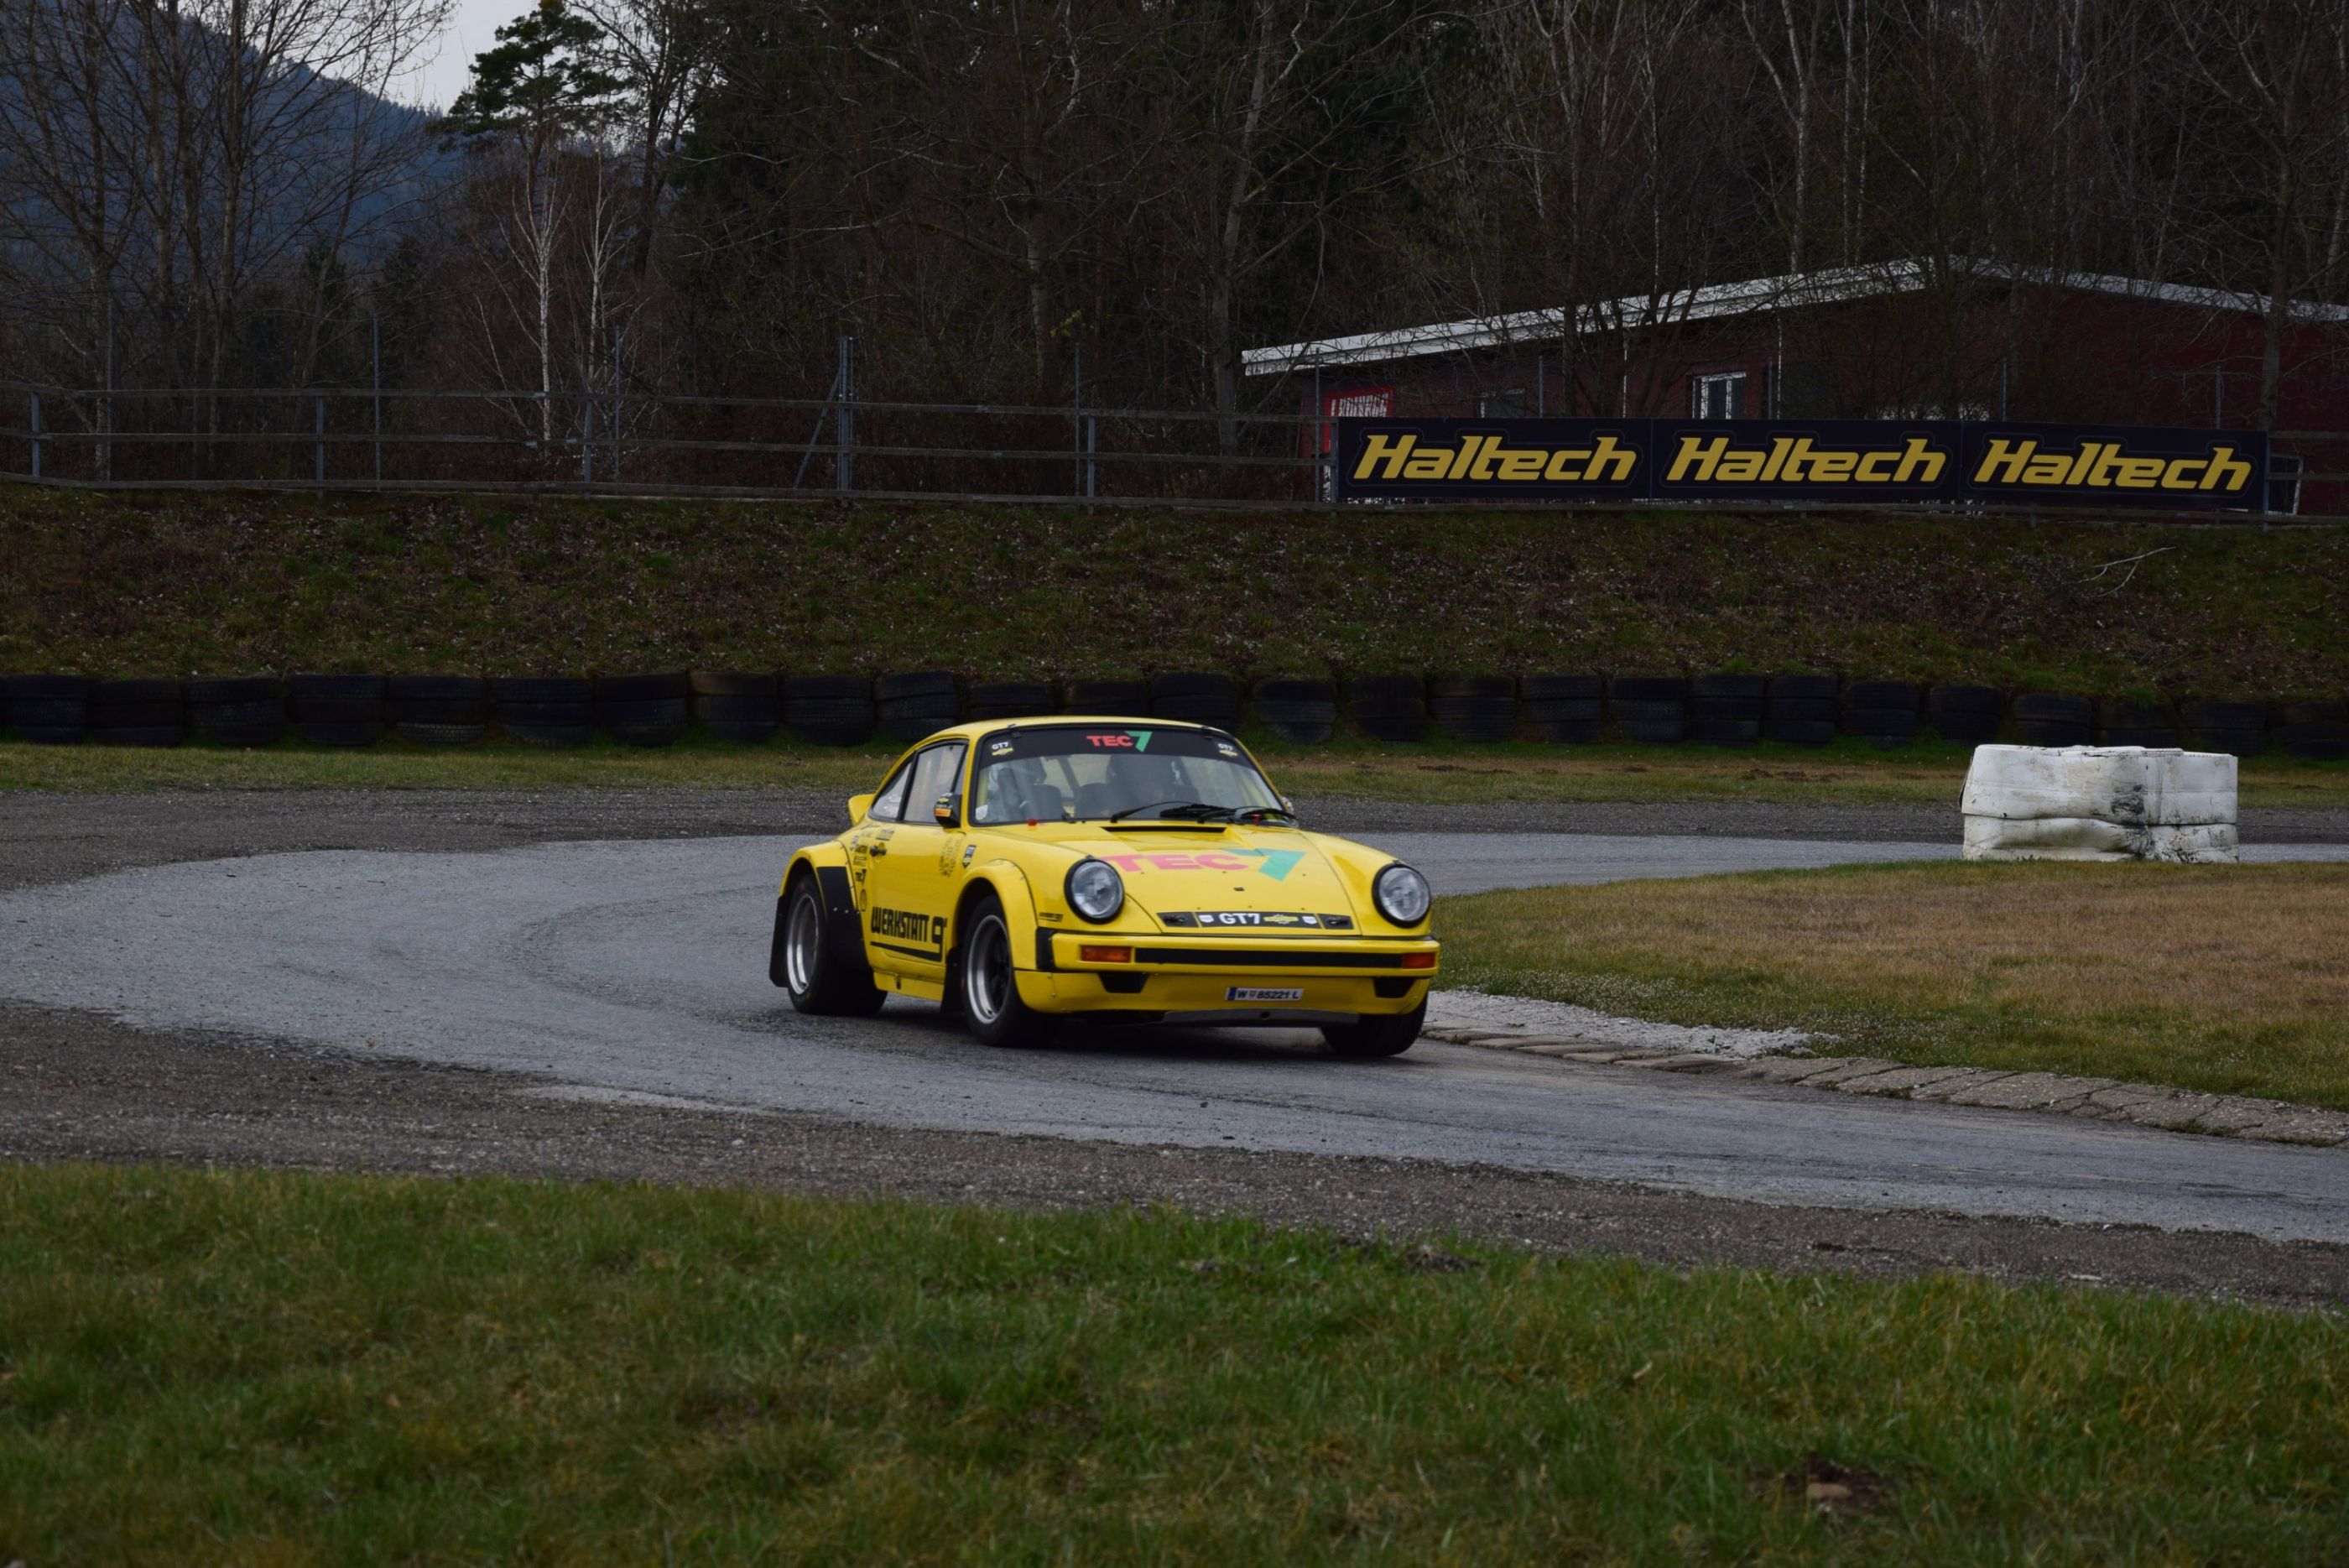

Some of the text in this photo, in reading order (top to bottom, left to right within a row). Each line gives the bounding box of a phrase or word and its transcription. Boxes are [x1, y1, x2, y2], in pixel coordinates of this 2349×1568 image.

[1354, 435, 1637, 481] Haltech
[1666, 437, 1946, 482] Haltech
[1974, 440, 2252, 491] Haltech
[871, 906, 930, 942] WERKSTATT
[1218, 912, 1260, 925] GT7
[1237, 990, 1248, 998] W
[1292, 990, 1300, 999] L
